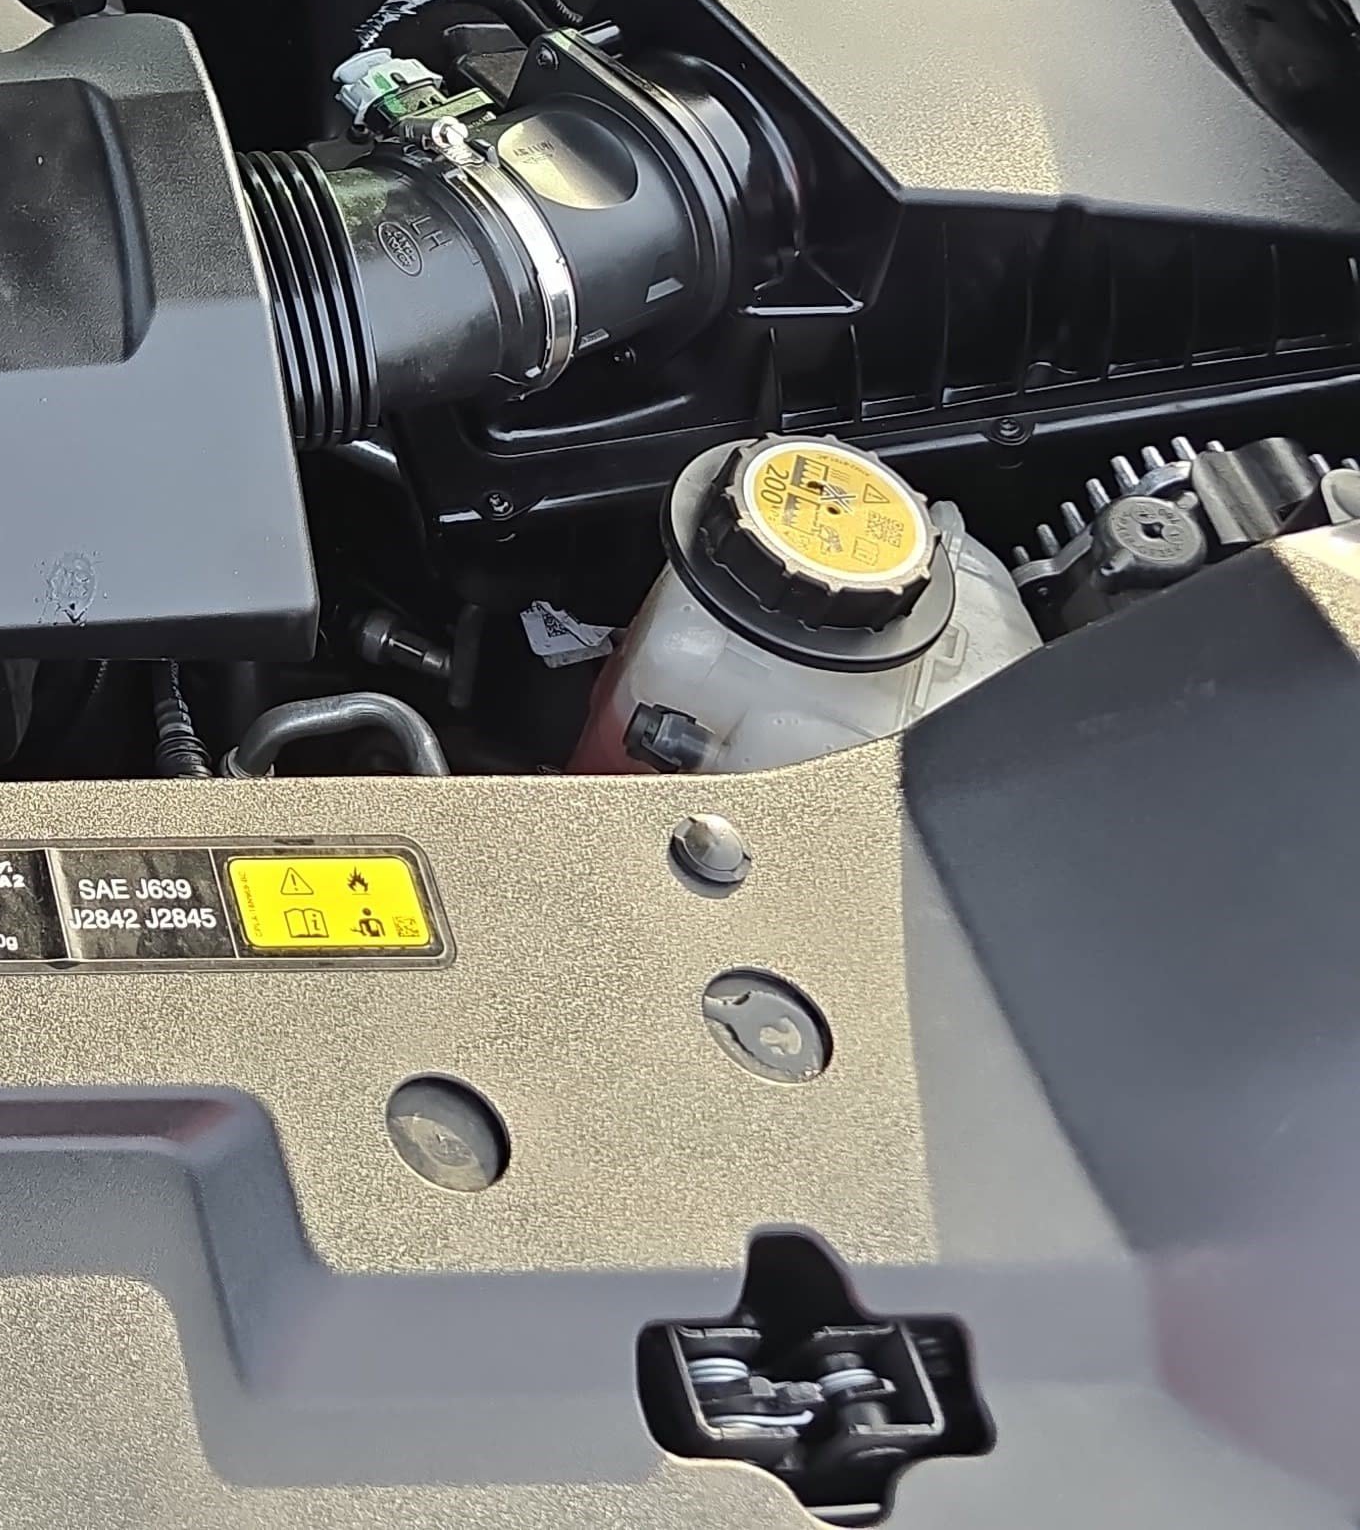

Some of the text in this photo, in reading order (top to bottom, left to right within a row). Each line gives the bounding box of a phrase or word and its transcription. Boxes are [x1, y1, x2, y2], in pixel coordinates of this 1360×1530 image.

[410, 214, 453, 252] LH
[760, 463, 790, 505] 200
[78, 878, 192, 900] SAE J639
[69, 908, 217, 929] J2842 J2845
